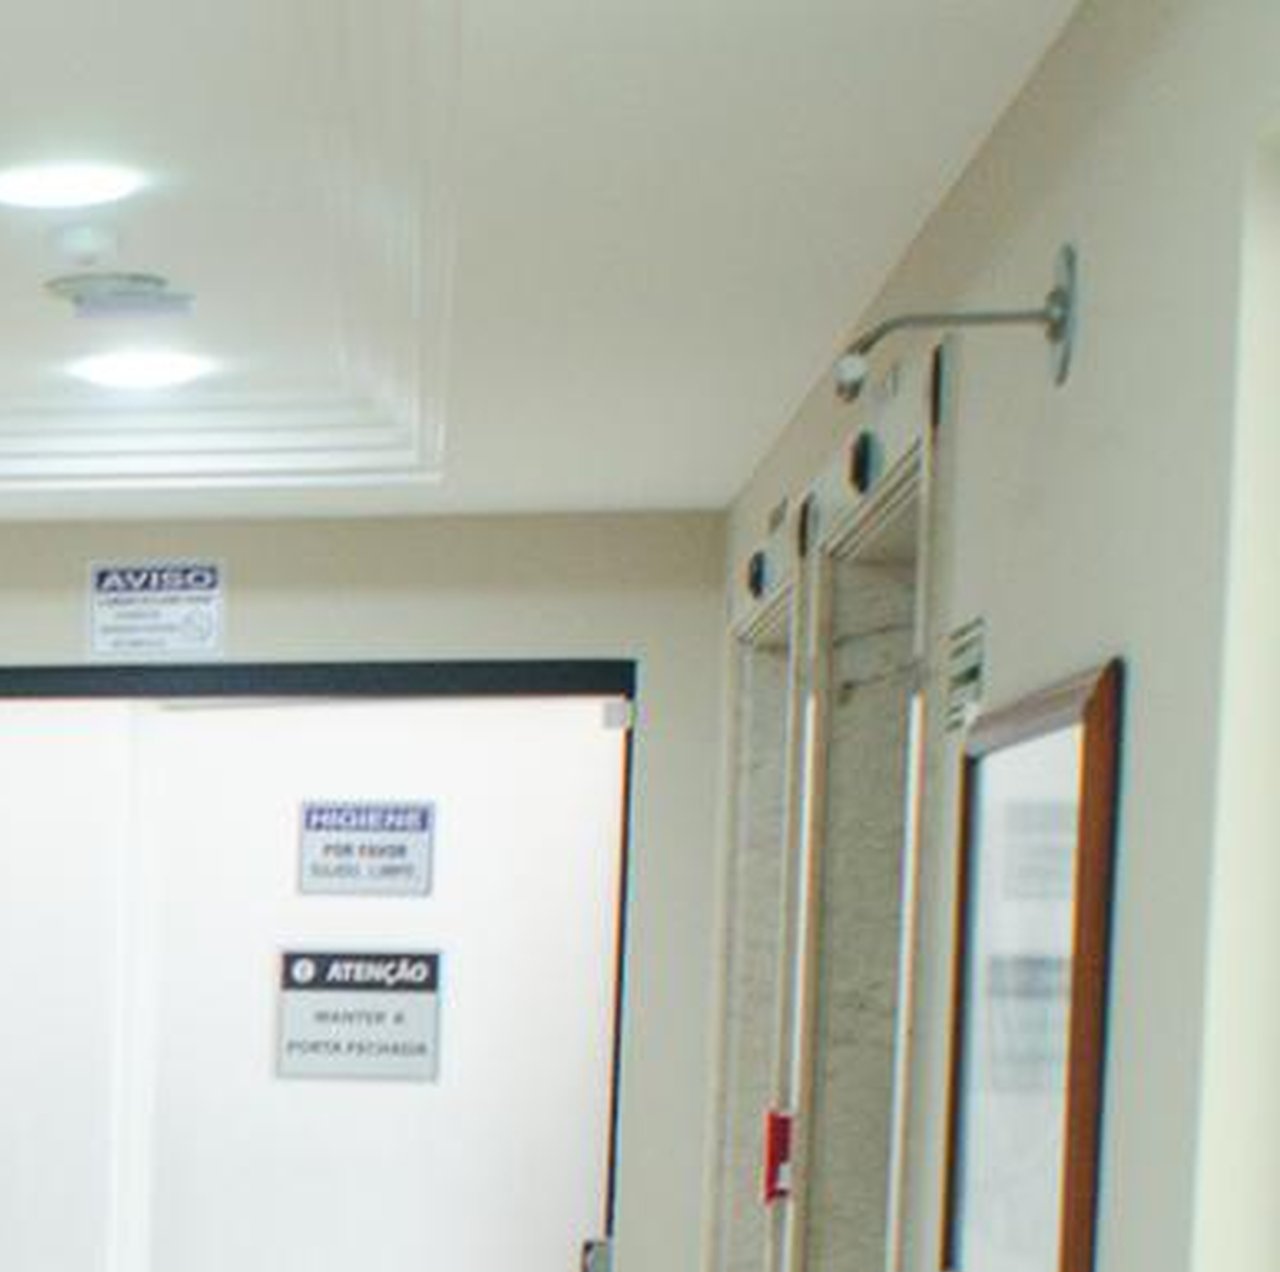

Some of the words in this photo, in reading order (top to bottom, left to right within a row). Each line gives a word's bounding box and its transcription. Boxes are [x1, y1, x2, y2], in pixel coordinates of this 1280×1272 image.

[101, 569, 214, 589] AVISO
[310, 808, 421, 828] HIGIENE
[326, 957, 429, 985] ATENÇÃO
[314, 1010, 386, 1025] MANTER
